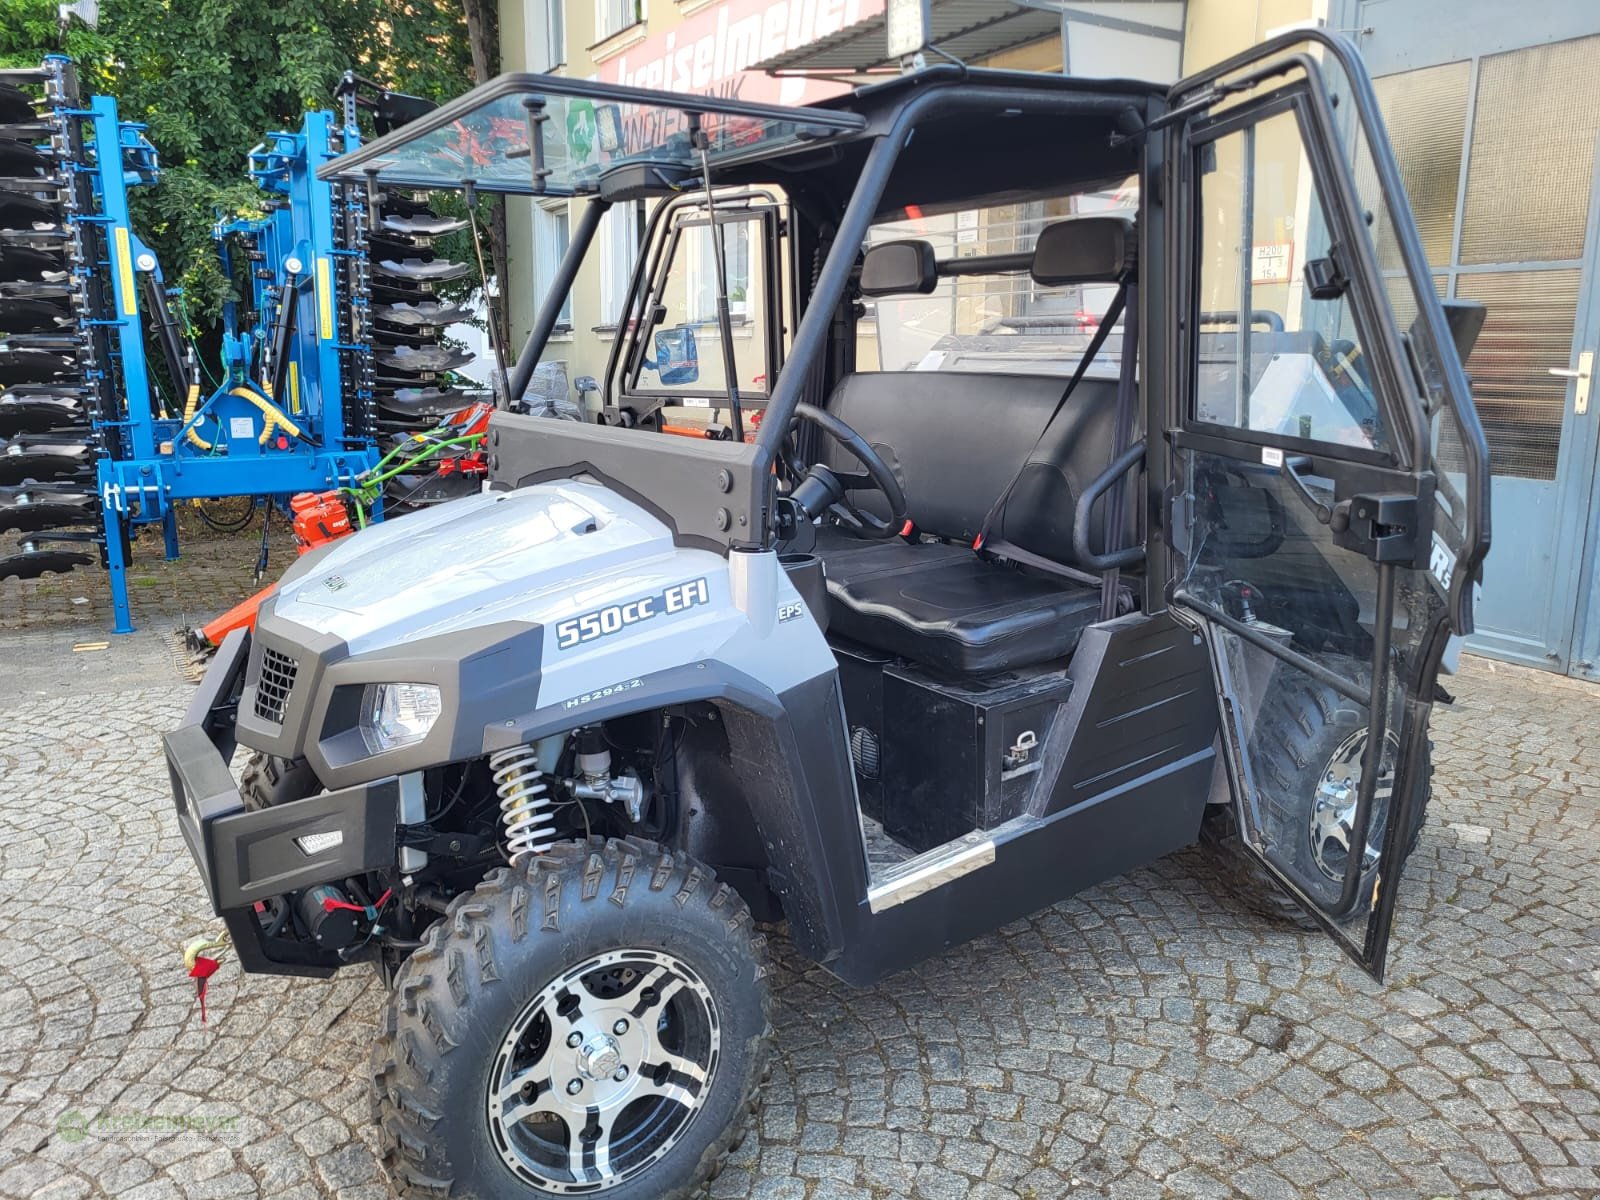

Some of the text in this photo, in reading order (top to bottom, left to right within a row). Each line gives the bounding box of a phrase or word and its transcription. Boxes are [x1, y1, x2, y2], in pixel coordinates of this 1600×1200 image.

[557, 577, 709, 650] 550cc EFI
[778, 602, 803, 621] EPS
[565, 679, 642, 709] HS294-2
